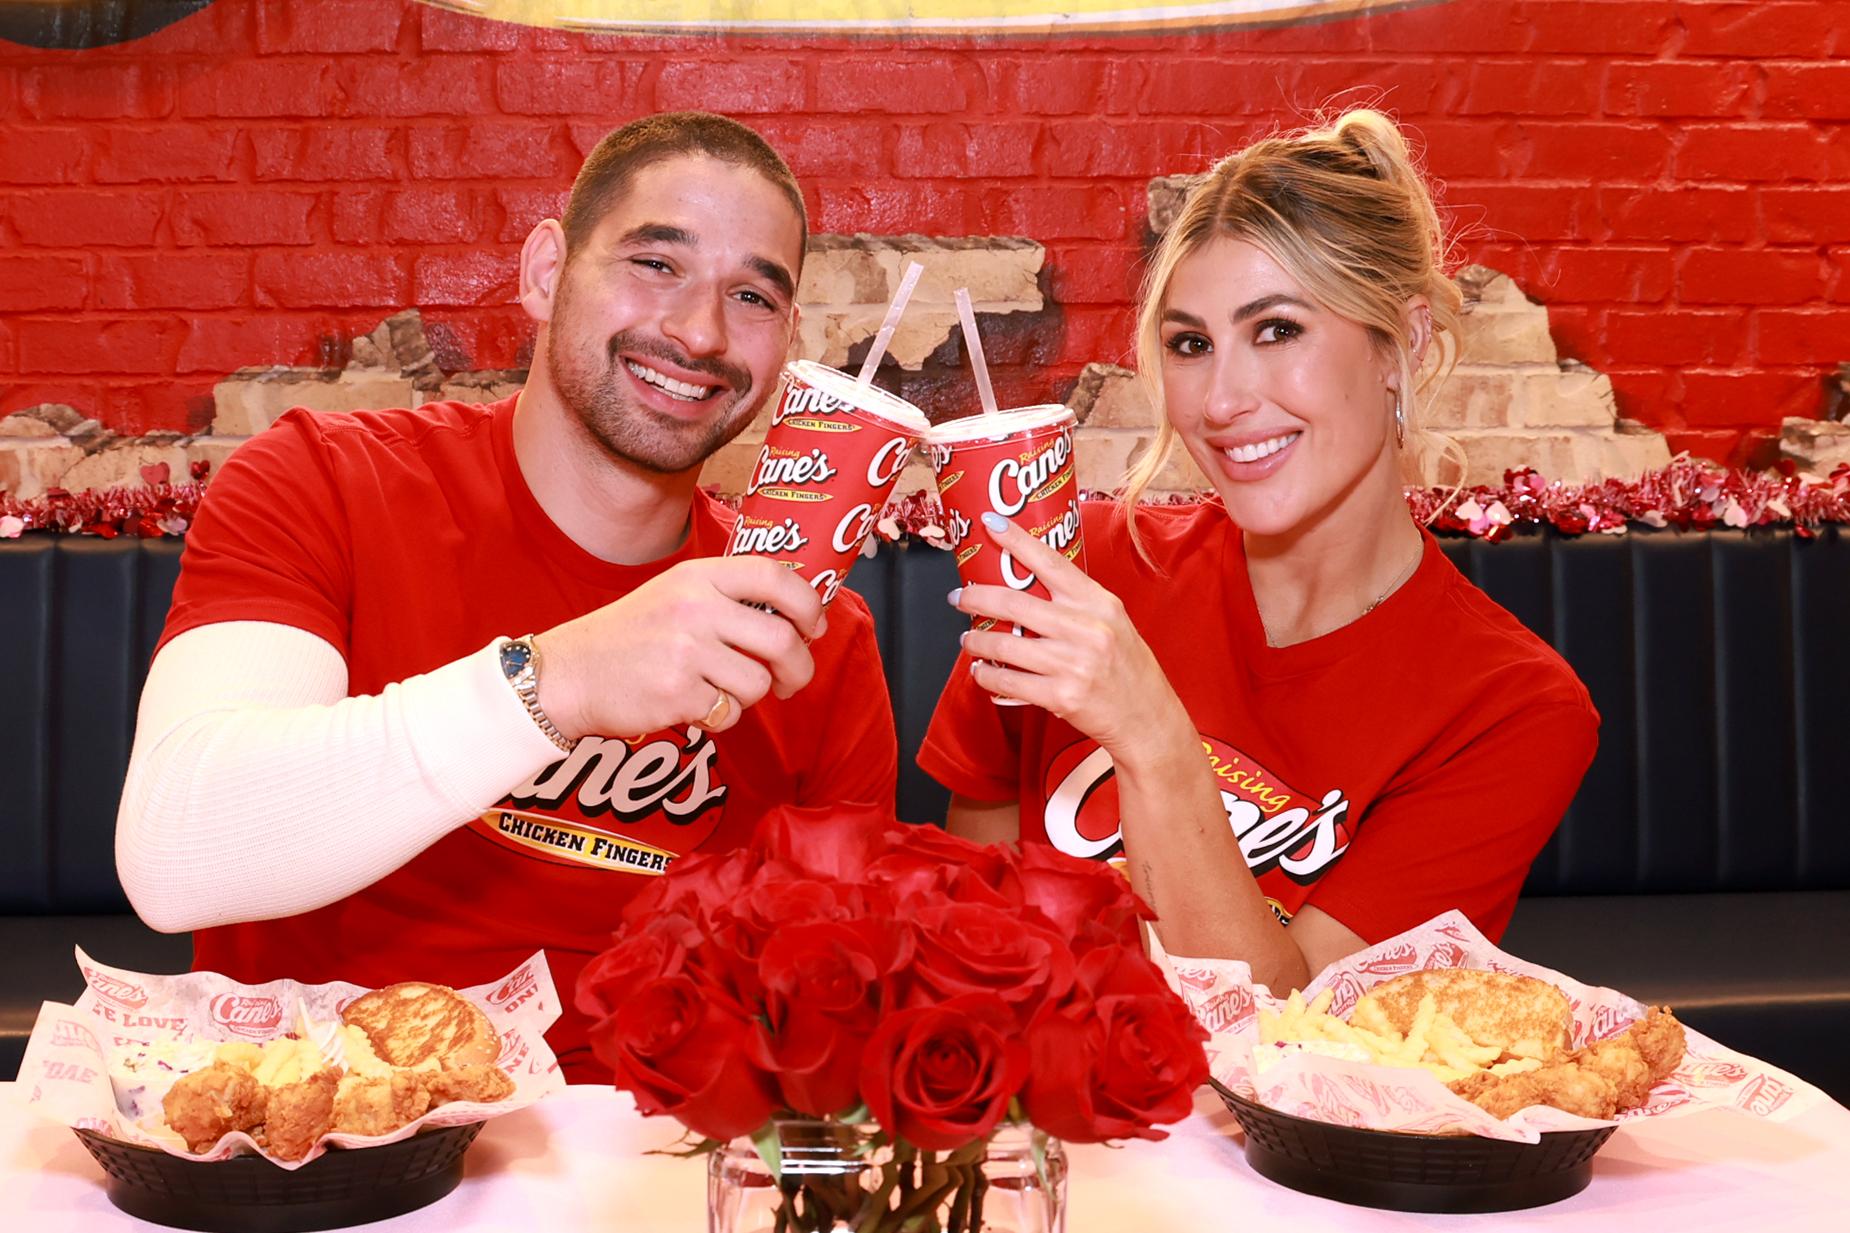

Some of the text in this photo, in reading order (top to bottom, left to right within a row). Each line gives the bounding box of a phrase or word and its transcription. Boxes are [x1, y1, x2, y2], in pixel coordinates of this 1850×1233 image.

[747, 445, 837, 496] Cane's
[510, 725, 728, 816] ane's
[498, 812, 586, 852] CHICKEN
[123, 1013, 185, 1032] LOVE
